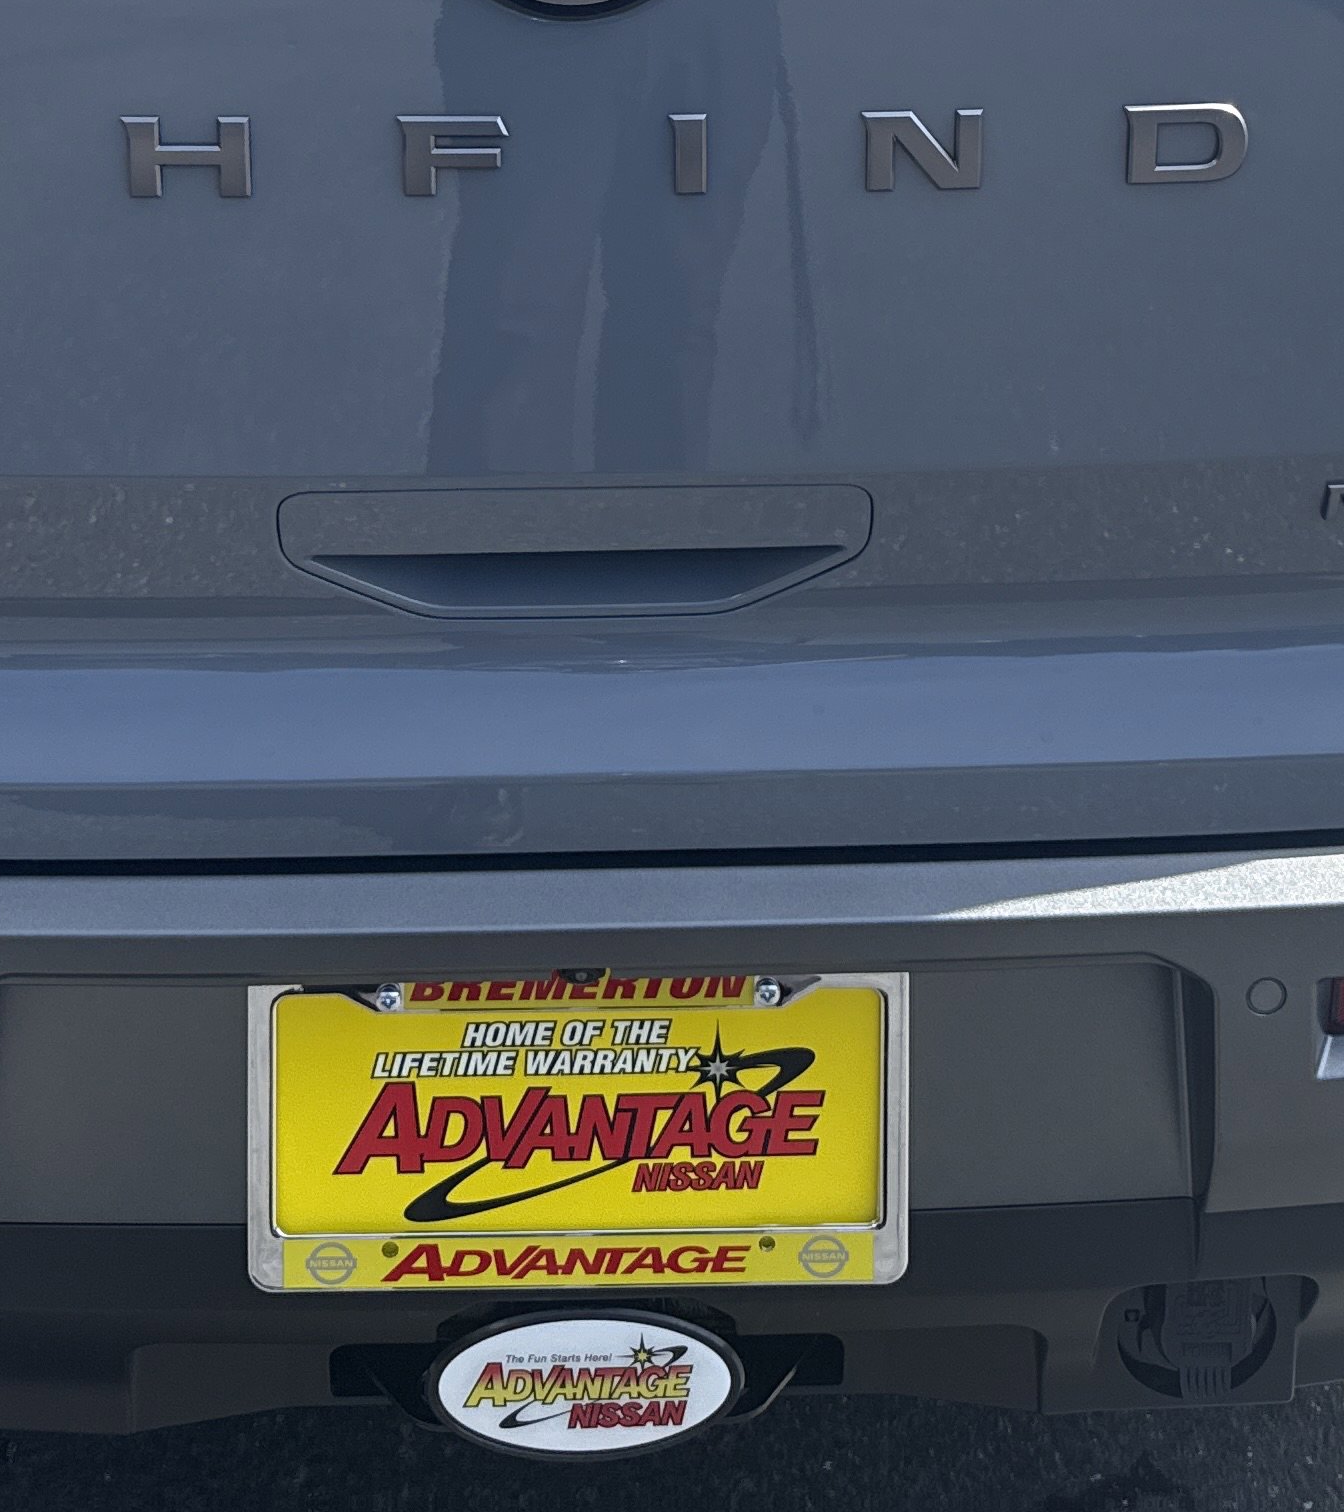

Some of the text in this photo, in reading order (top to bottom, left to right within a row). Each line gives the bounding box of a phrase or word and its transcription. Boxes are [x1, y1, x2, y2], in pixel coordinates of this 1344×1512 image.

[461, 1017, 673, 1049] HOME OF THE
[371, 1045, 700, 1080] LIFETIME WARRANTY
[332, 1081, 826, 1176] ADVANTAGE
[631, 1160, 764, 1193] NISSAN
[309, 1259, 354, 1268] NISSAN
[379, 1243, 752, 1283] ADVANTAGE
[801, 1251, 847, 1262] NISSAN
[505, 1352, 613, 1364] The Fun Starts Here!
[462, 1361, 694, 1409] ADVANTAGE
[567, 1399, 688, 1430] NISSAN
